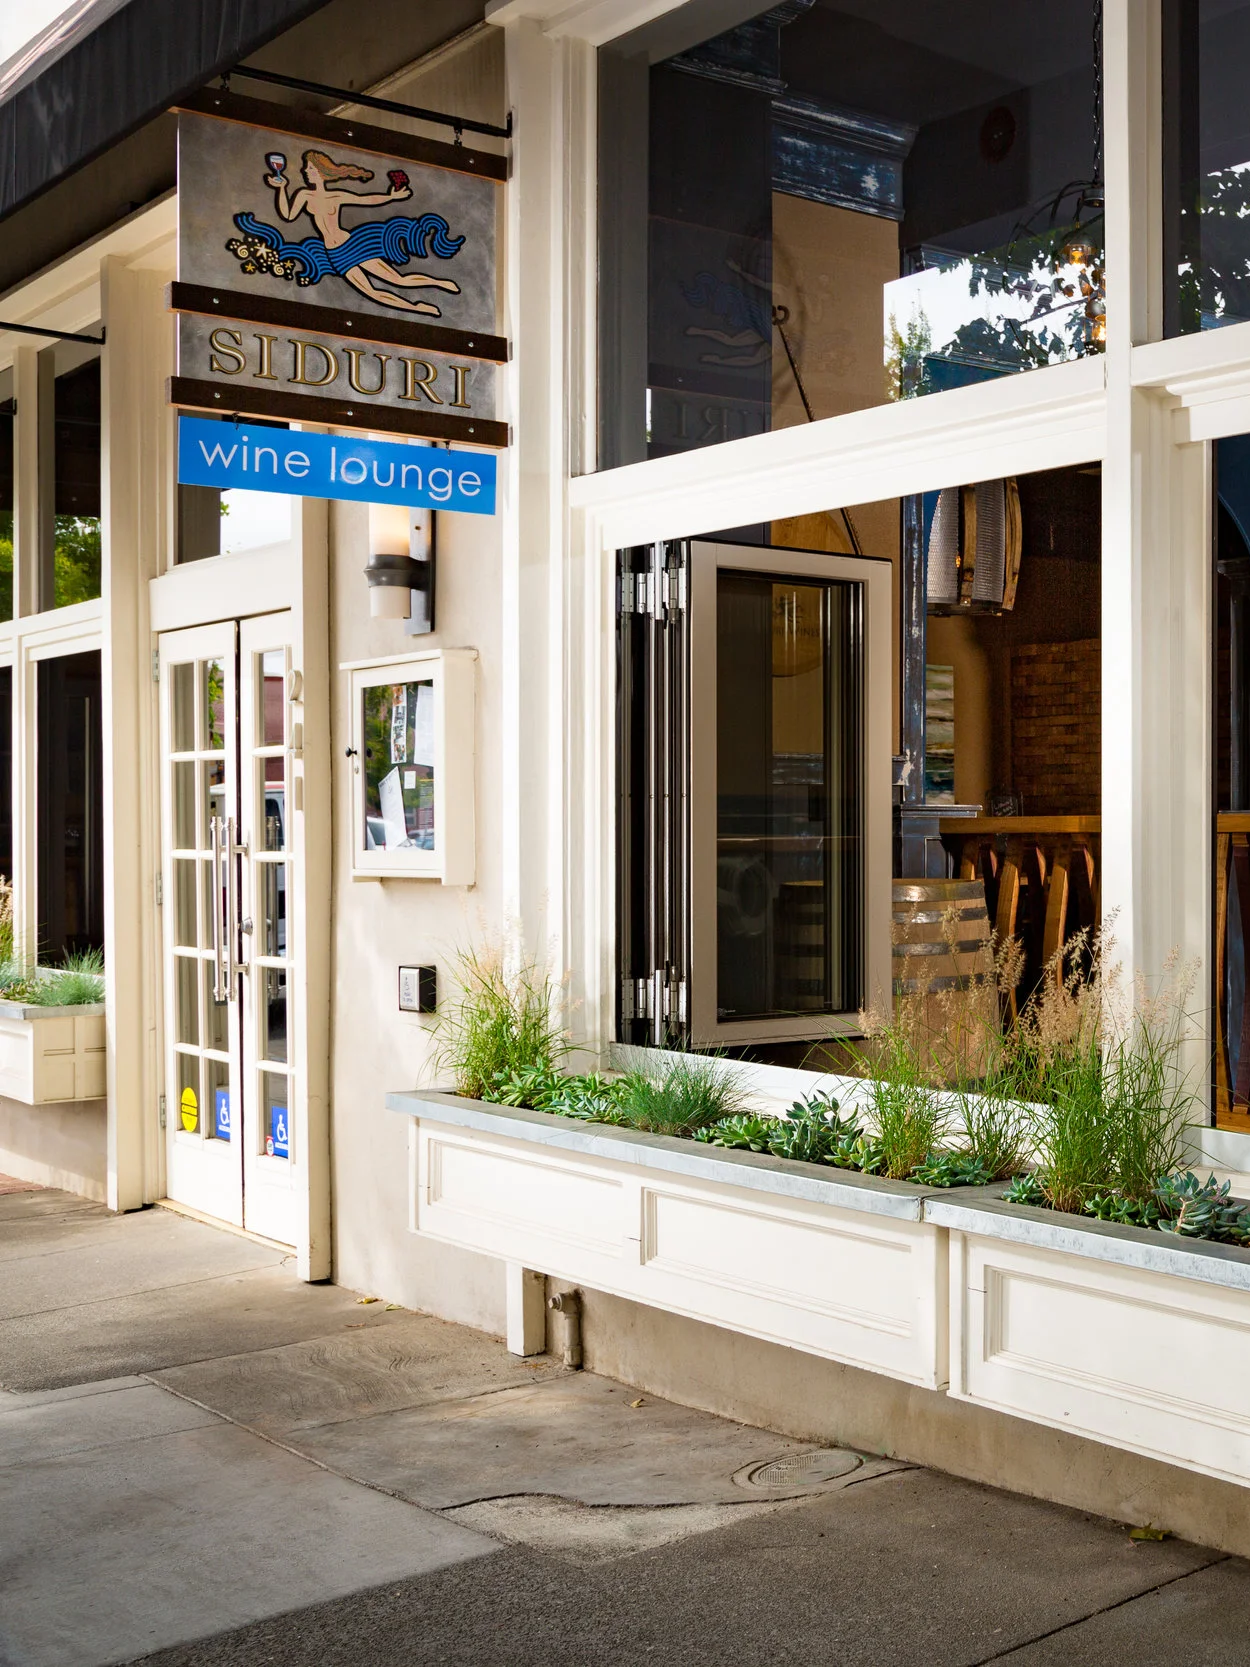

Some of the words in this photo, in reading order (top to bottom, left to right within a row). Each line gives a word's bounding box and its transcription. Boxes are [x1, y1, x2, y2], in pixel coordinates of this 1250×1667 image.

[209, 326, 472, 410] SIDURI
[198, 435, 311, 478] wine
[329, 445, 482, 502] lounge
